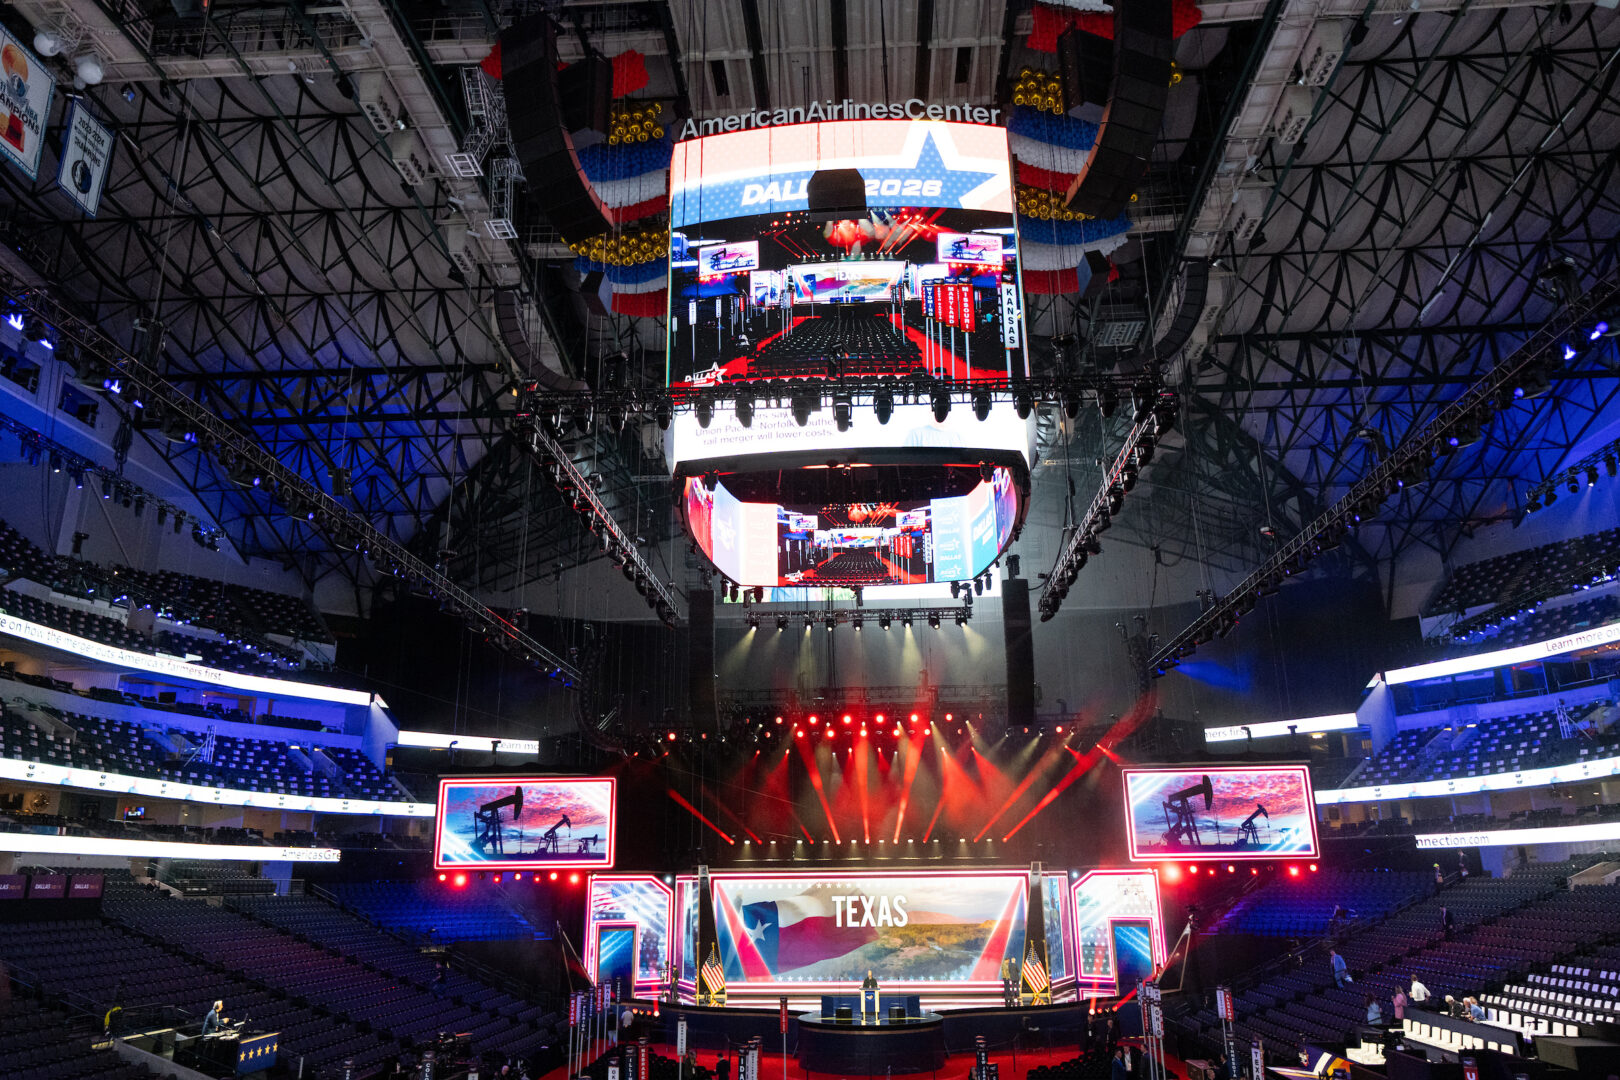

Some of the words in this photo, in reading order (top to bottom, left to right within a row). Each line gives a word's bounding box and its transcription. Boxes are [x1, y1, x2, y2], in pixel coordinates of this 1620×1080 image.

[25, 105, 38, 123] NBA
[680, 98, 1001, 141] AmericanAirlinesCenter
[741, 181, 809, 206] DALL
[864, 179, 943, 197] 2026
[962, 286, 970, 329] MISSOURI
[1006, 288, 1016, 344] KANSAS
[684, 371, 716, 383] DALLAS
[695, 427, 722, 437] Union
[703, 437, 718, 446] rail
[720, 434, 754, 444] merger
[757, 431, 773, 440] will
[776, 430, 801, 439] lower
[8, 622, 22, 632] on
[47, 631, 62, 644] the
[1545, 639, 1574, 652] Learn
[1575, 631, 1604, 645] more
[499, 742, 522, 751] earn
[831, 895, 909, 928] TEXAS
[1229, 1041, 1237, 1078] MINNESOTA
